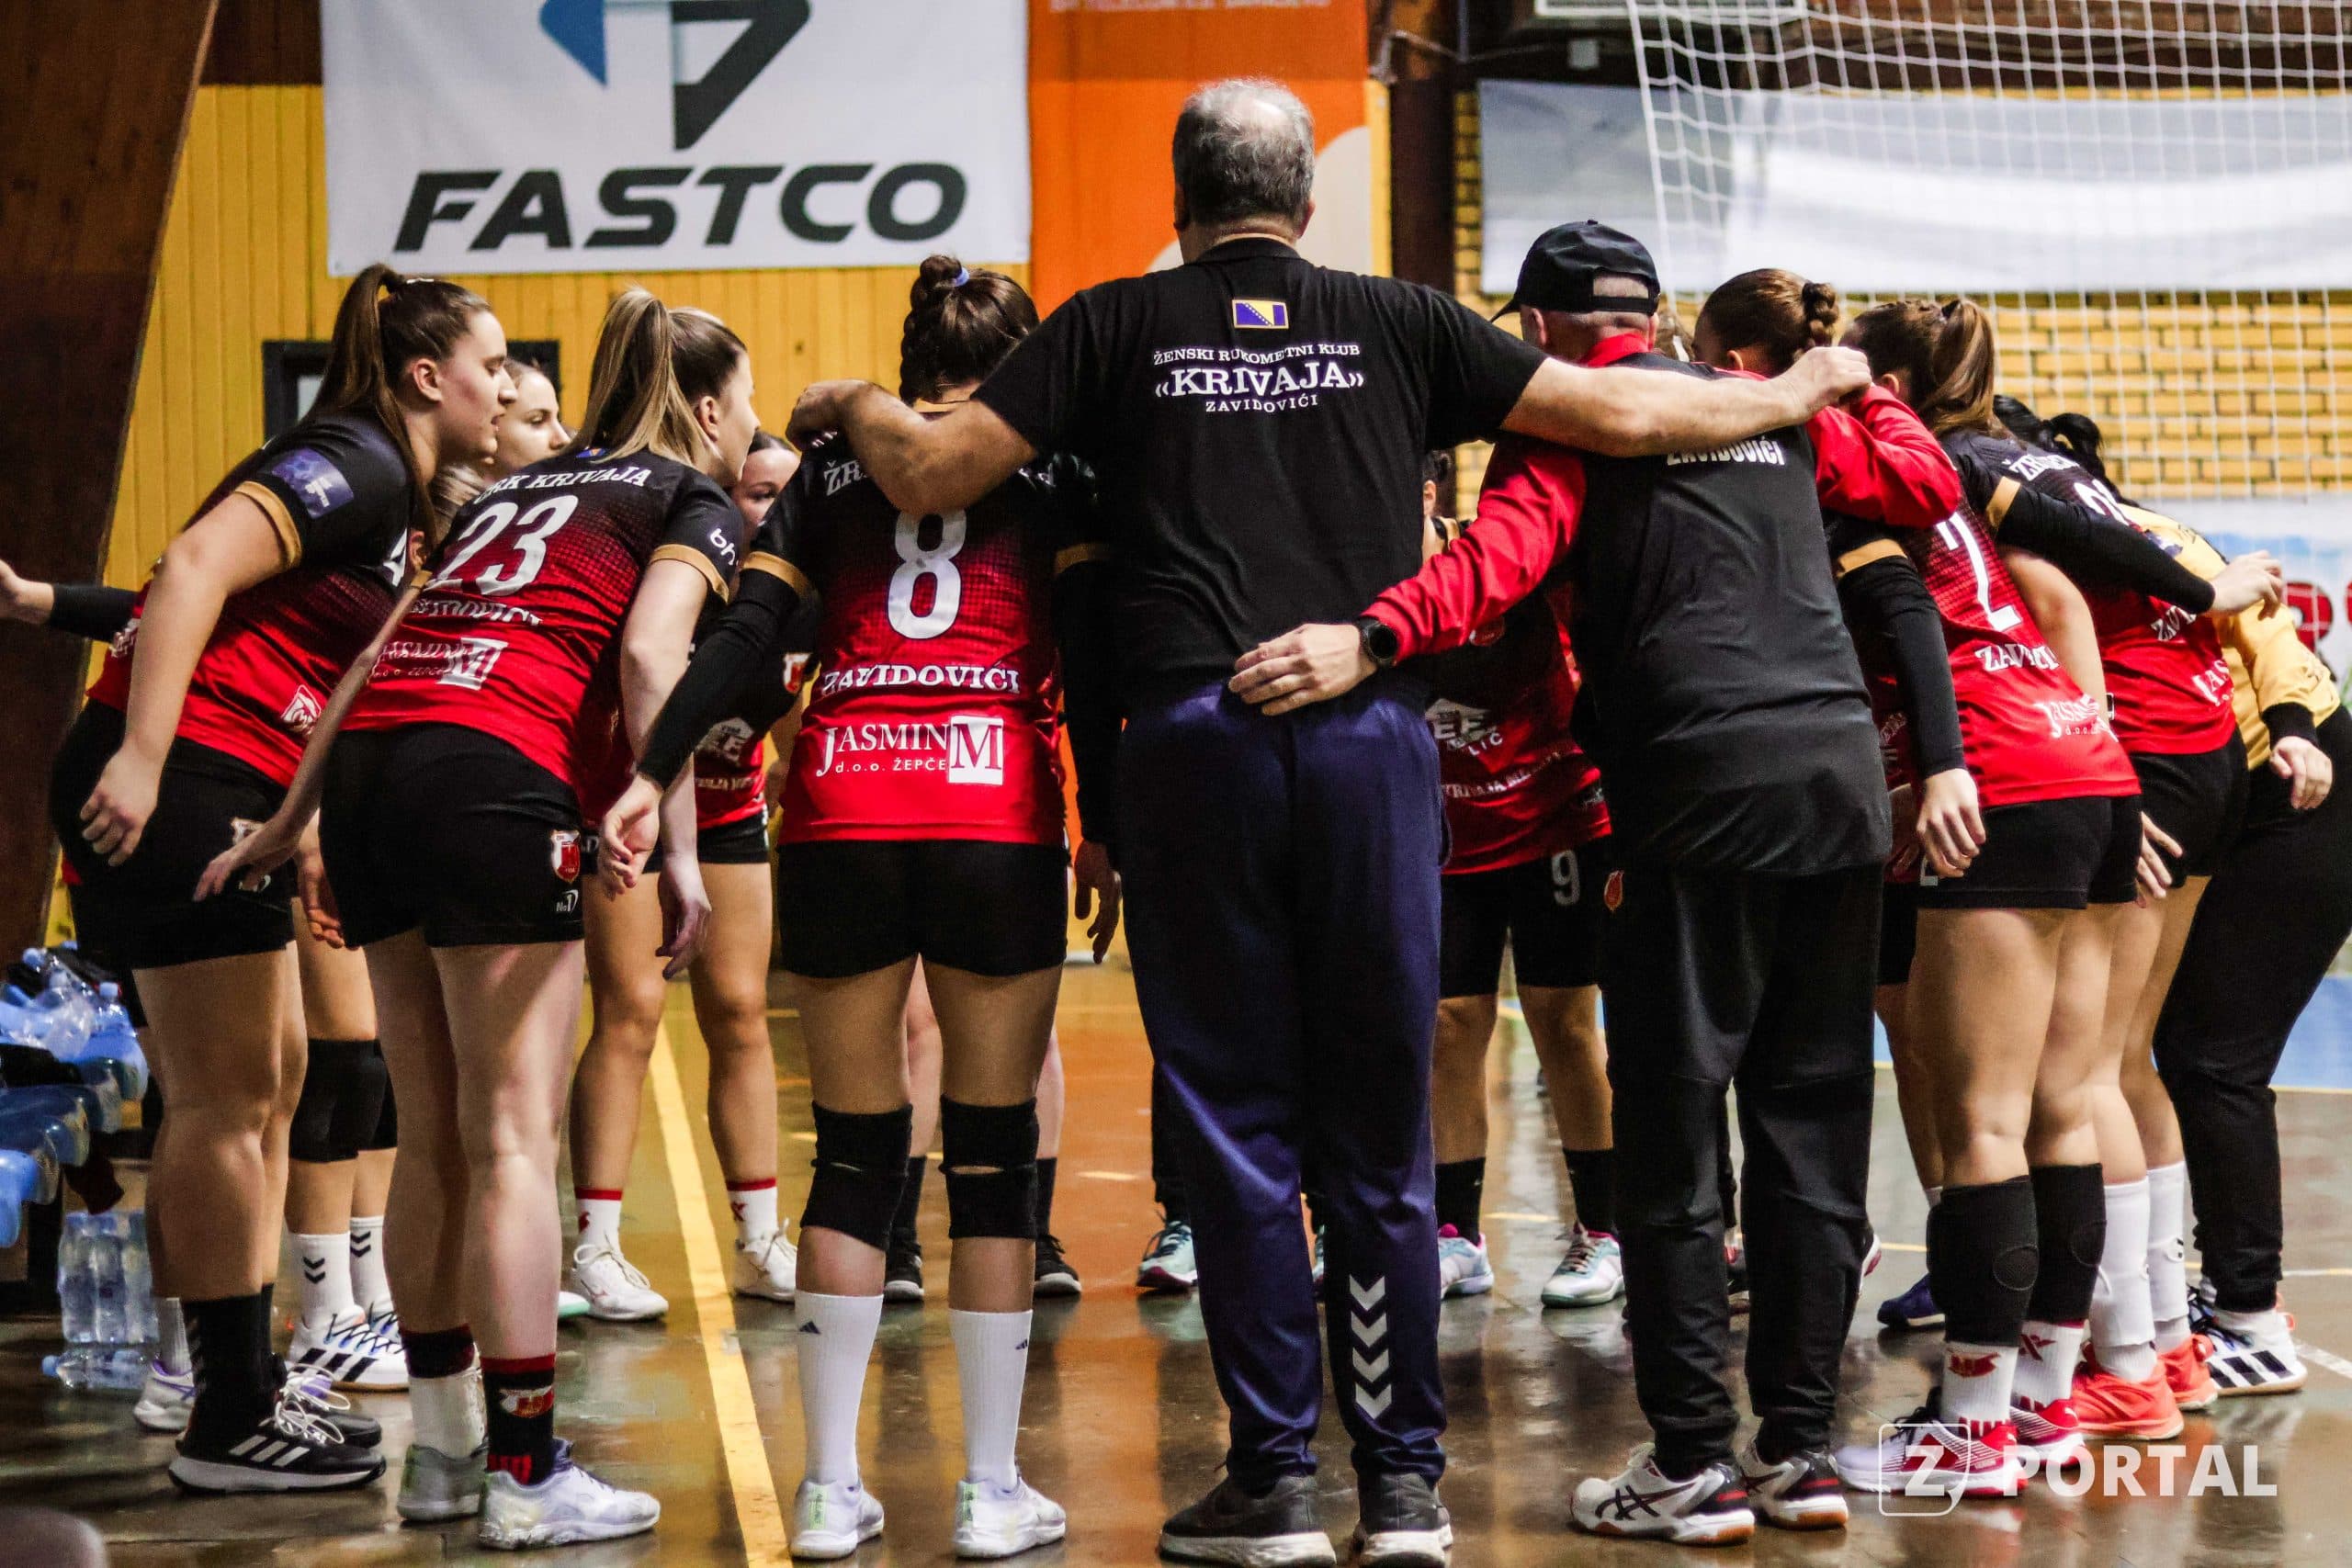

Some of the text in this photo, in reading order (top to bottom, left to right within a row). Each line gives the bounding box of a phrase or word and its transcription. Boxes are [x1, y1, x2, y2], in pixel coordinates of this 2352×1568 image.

[393, 163, 967, 253] FASTCO
[1154, 343, 1361, 365] ŽENSKI RUKOMETNI KLUB
[1205, 393, 1318, 412] ZAVIDOVIĆI
[526, 466, 652, 490] KRIVAJA
[824, 458, 868, 496] ŽR
[423, 494, 579, 596] 23
[887, 508, 967, 640] 8
[821, 660, 1021, 696] ZAVIDOVIĆI
[892, 757, 946, 772] ŽEPČE
[1551, 850, 1580, 907] 9
